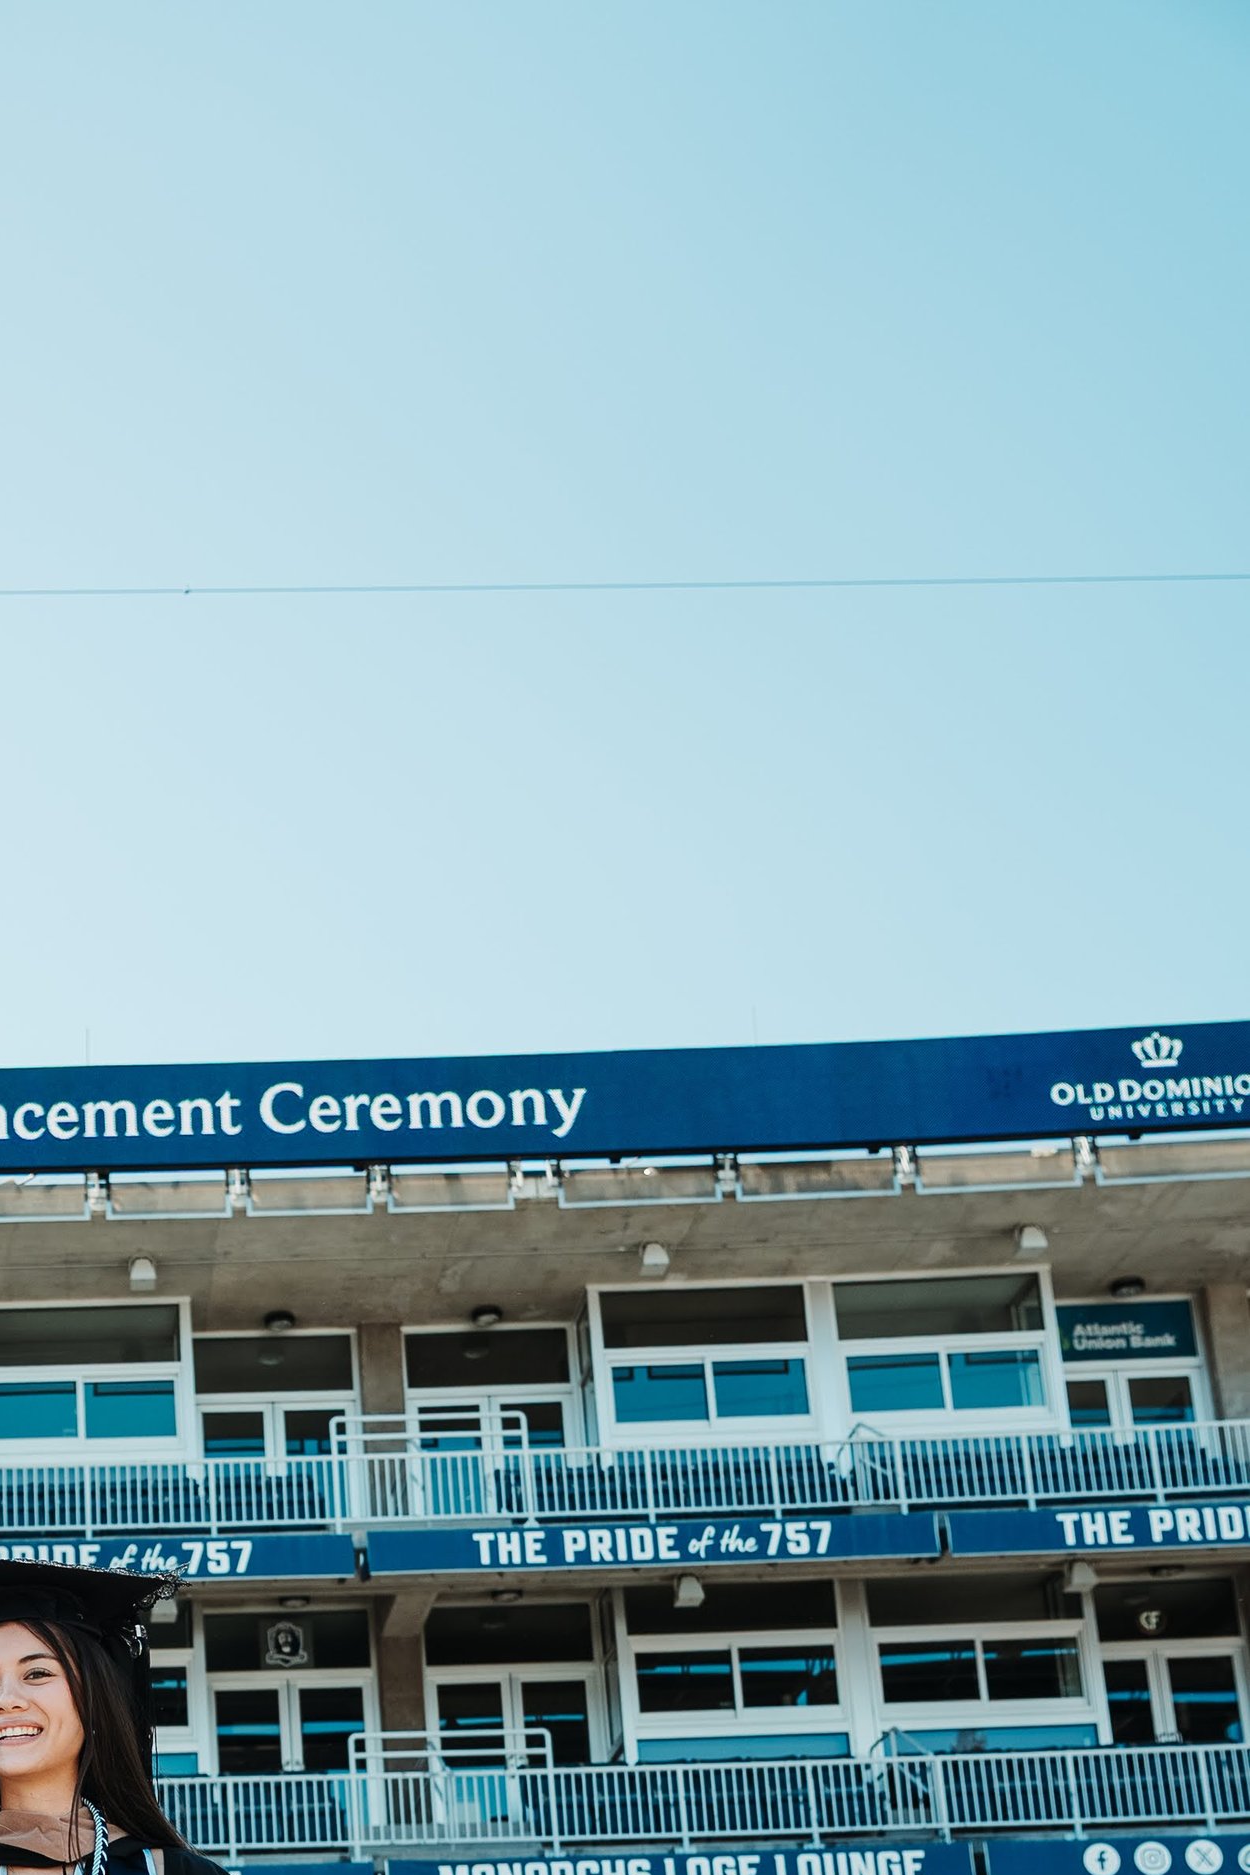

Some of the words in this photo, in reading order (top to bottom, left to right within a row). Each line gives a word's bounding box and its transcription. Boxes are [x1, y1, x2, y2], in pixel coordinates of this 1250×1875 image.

[1050, 1082, 1115, 1106] OLD
[1118, 1074, 1250, 1102] DOMINIO
[260, 1082, 587, 1138] Ceremony
[1090, 1098, 1245, 1121] UNIVERSITY
[1072, 1321, 1144, 1336] Atlantic
[1072, 1336, 1126, 1350] Union
[1129, 1333, 1176, 1348] Bank
[1055, 1510, 1135, 1546] THE
[1148, 1505, 1250, 1543] PRID
[109, 1544, 138, 1571] of
[141, 1543, 178, 1572] the
[181, 1540, 252, 1575] 757
[472, 1531, 547, 1566] THE
[562, 1526, 681, 1562] PRIDE
[688, 1526, 716, 1558] of
[719, 1524, 758, 1553] the
[760, 1521, 832, 1556] 757
